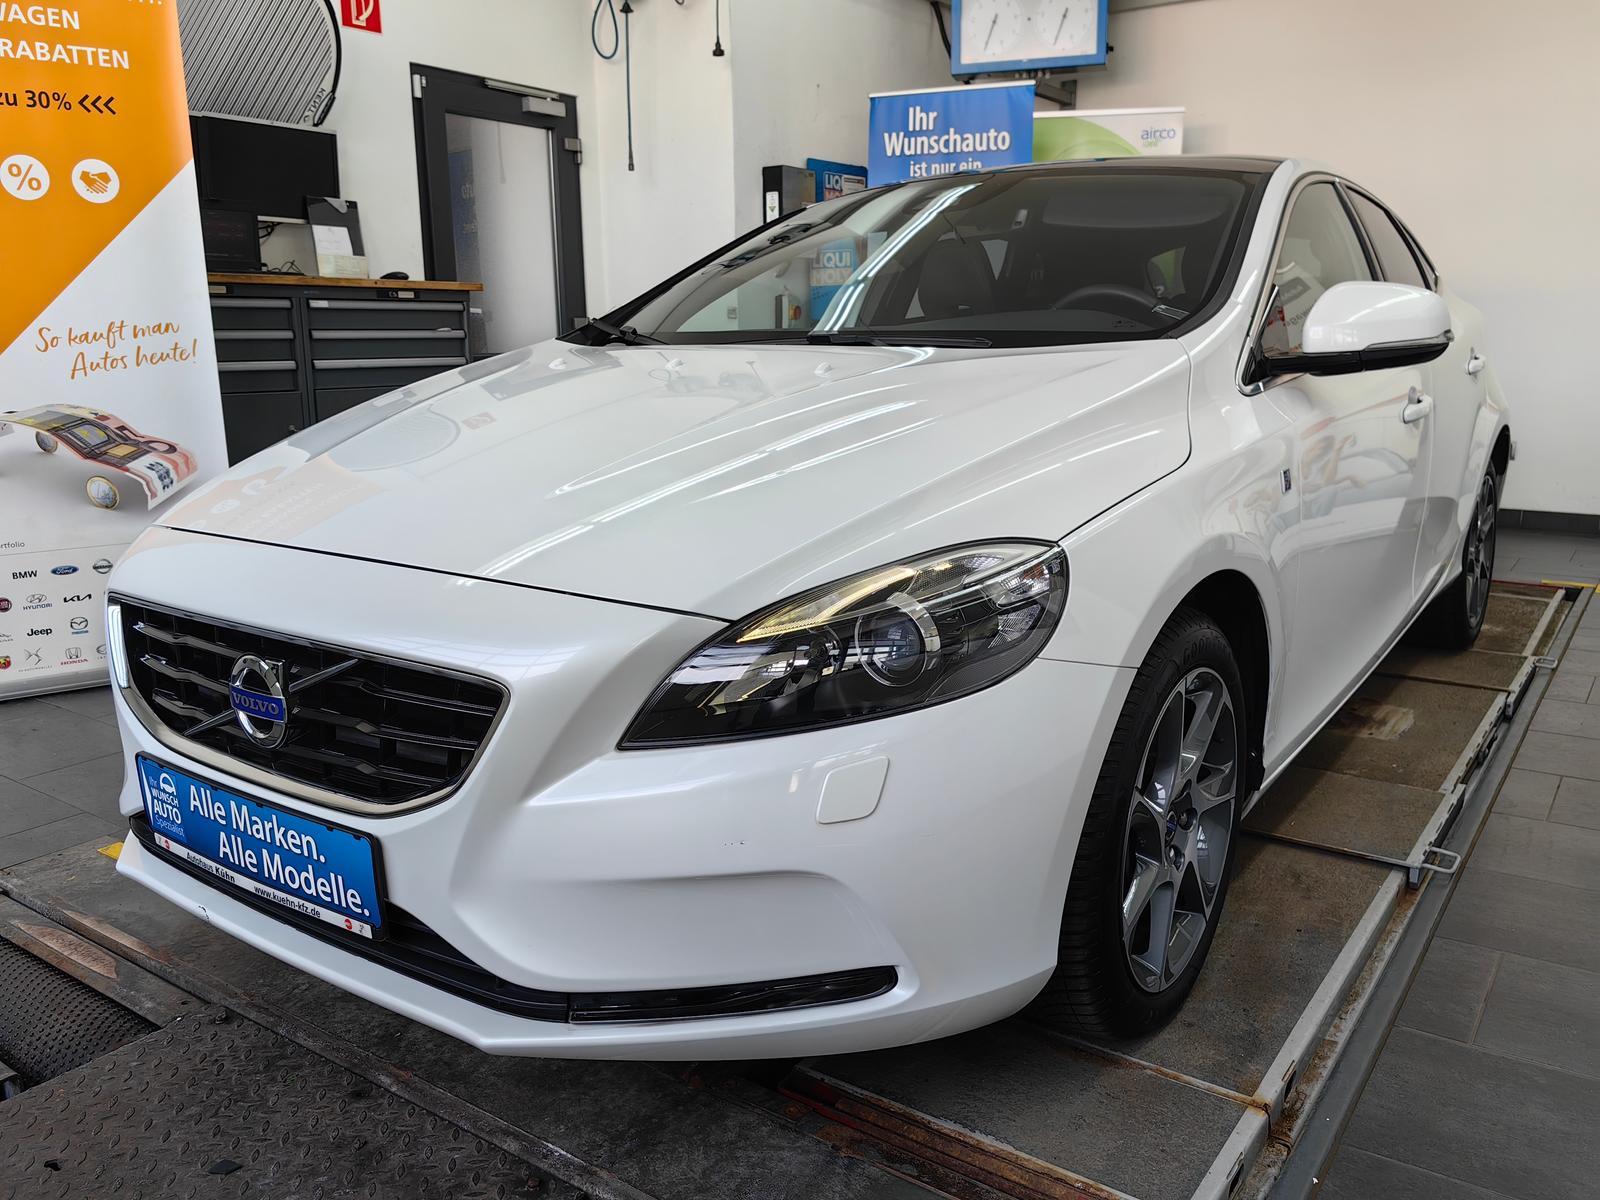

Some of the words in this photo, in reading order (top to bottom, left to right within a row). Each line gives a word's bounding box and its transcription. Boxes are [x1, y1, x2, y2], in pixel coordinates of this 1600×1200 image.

[0, 38, 130, 70] RABATTEN
[25, 89, 72, 111] 30%
[908, 106, 938, 131] Ihr
[883, 128, 1011, 156] Wunschauto
[1141, 127, 1176, 140] airco
[910, 160, 928, 177] ist
[931, 161, 956, 175] nur
[812, 251, 850, 268] LIQUI
[36, 327, 62, 352] So
[68, 320, 128, 349] kauft
[133, 320, 180, 340] man
[71, 352, 128, 380] Autos
[136, 339, 197, 368] heute!
[12, 570, 38, 580] BMW
[23, 603, 53, 611] HYUNDAI
[27, 627, 53, 637] Jeep
[60, 658, 88, 666] HONDA
[231, 690, 279, 715] VOLVO
[150, 786, 179, 808] WUNSCH
[154, 799, 182, 825] AUTO
[155, 815, 185, 837] Spezialist
[189, 784, 227, 826] Alle
[230, 801, 327, 864] Marken.
[186, 851, 215, 874] Autohaus
[214, 865, 236, 884] Kühn
[253, 884, 321, 918] www.kuehn-kfz.de
[218, 831, 259, 873] Alle
[262, 848, 371, 917] Modelle.
